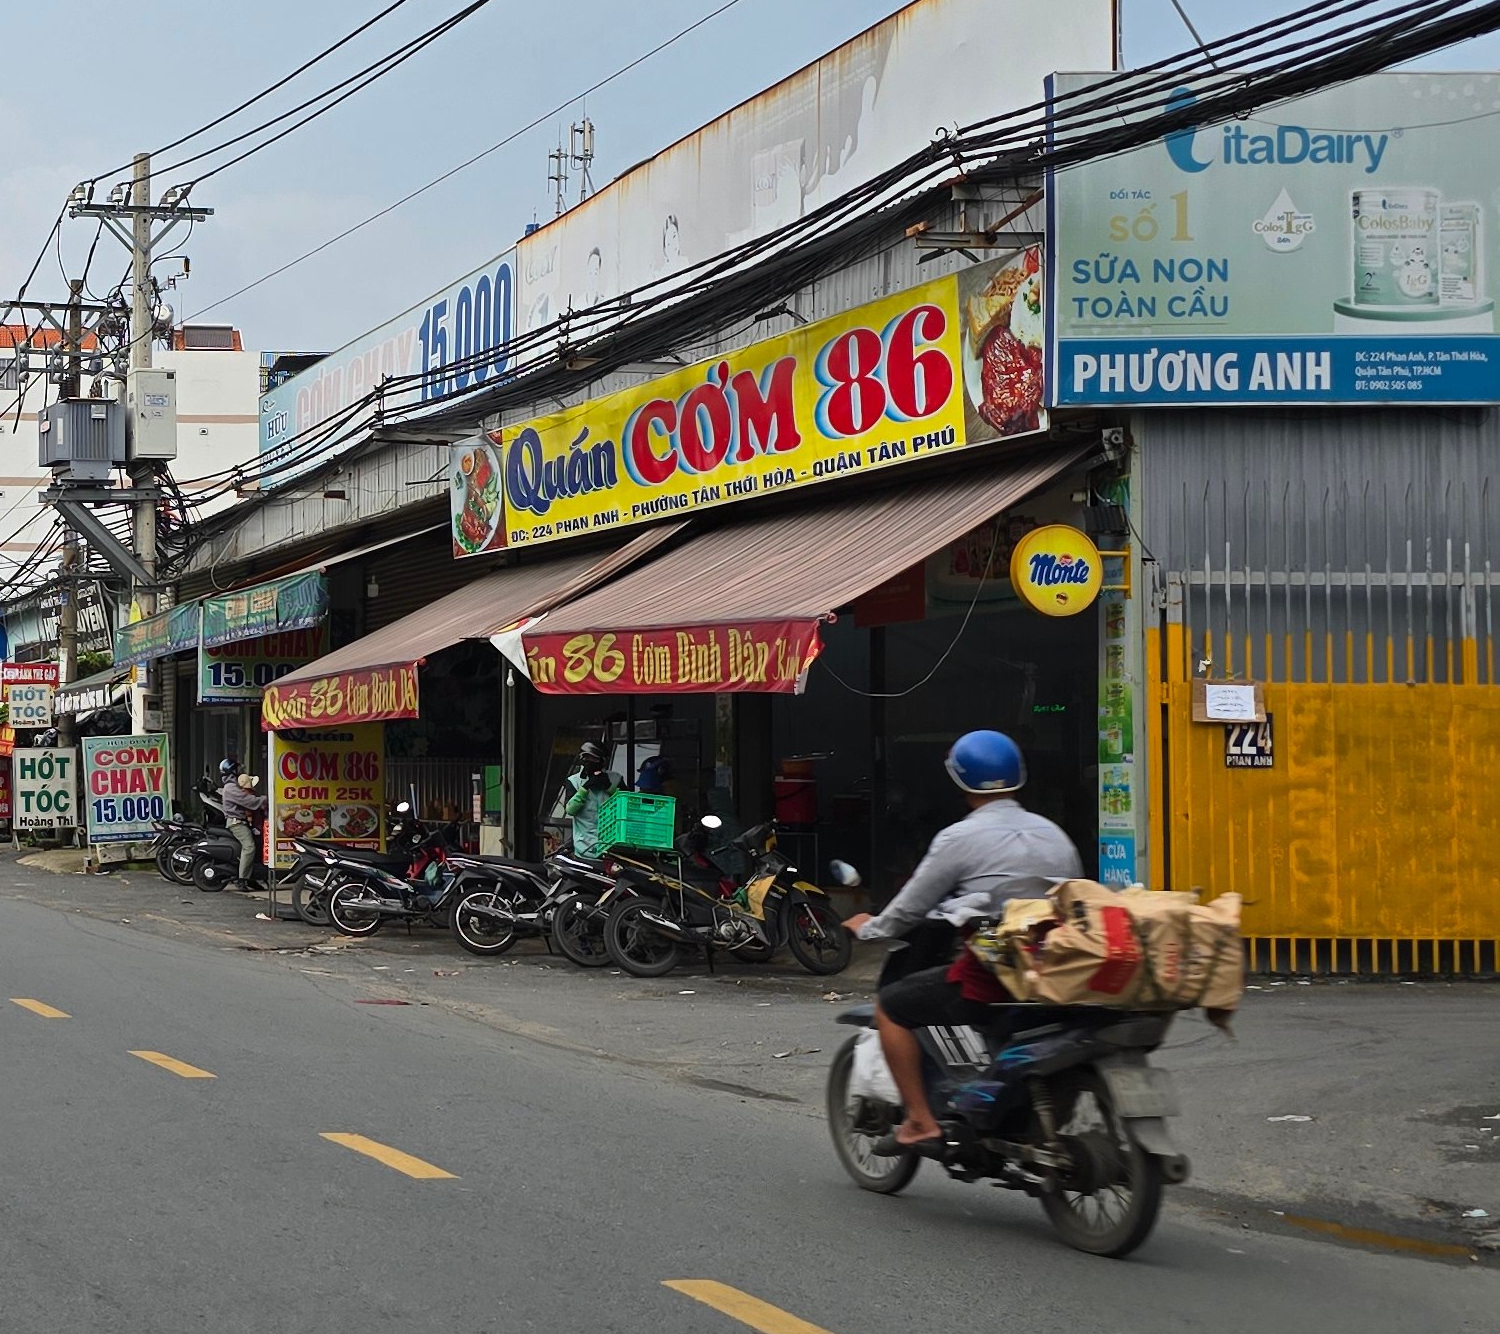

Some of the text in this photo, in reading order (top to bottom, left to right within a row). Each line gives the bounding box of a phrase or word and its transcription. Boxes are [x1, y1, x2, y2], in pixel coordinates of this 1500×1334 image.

[1358, 214, 1436, 233] ColosBaby
[1072, 252, 1230, 285] SỮA NON
[1072, 285, 1230, 319] TOÀN CẦU
[1074, 347, 1331, 393] PHƯƠNG ANH
[506, 305, 954, 516] Quán CƠM 86
[532, 524, 553, 540] 224
[556, 516, 590, 535] PHAN
[593, 509, 620, 526] ANH
[631, 494, 689, 519] PHƯỜNG
[692, 486, 721, 506] TÂN
[724, 475, 758, 497] THỚI
[763, 466, 796, 488] HÒA
[812, 451, 862, 476] QUẬN
[867, 441, 906, 464] TÂN
[912, 424, 956, 454] PHÚ
[1029, 553, 1090, 586] Monte
[562, 633, 626, 684] 86
[632, 633, 673, 685] Cơm
[675, 628, 722, 685] Bình
[727, 628, 768, 684] Dân
[309, 676, 344, 717] 86
[346, 675, 369, 716] Cơm
[371, 669, 400, 714] Bình
[11, 703, 47, 718] TÓC
[19, 750, 71, 781] HỚT
[93, 746, 160, 767] CƠM
[278, 747, 380, 782] CƠM 86
[1226, 755, 1273, 766] PHAN ANH
[90, 767, 164, 796] CHAY
[283, 785, 374, 801] CƠM 25K
[19, 783, 71, 813] TÓC
[92, 795, 165, 824] 15.000
[1106, 840, 1126, 860] CỬA
